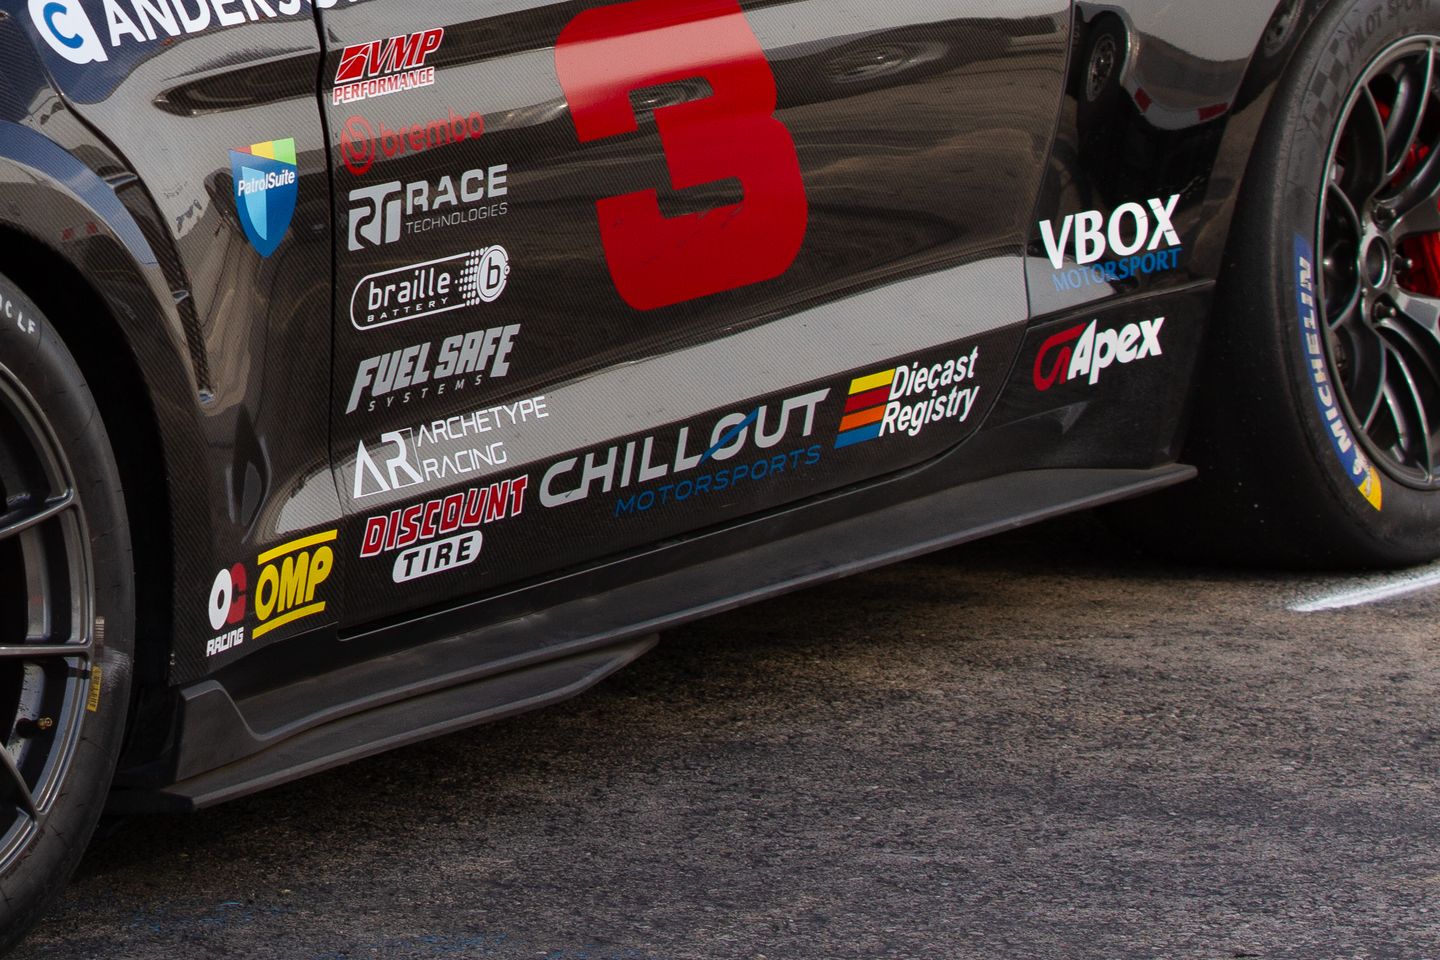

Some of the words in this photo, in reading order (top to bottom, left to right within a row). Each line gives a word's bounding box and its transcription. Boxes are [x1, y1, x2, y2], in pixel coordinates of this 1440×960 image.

[367, 27, 444, 76] VMP
[333, 67, 435, 105] PERFORMANCE
[379, 107, 484, 157] brembo
[238, 170, 295, 196] PatrolSuite
[406, 164, 508, 215] RACE
[406, 202, 508, 234] TECHNOLOGIES
[1039, 194, 1181, 269] VBOX
[368, 267, 450, 310] braille
[1052, 247, 1183, 292] MOTORSPORT
[17, 312, 35, 334] LF
[367, 296, 448, 322] BATTERY
[888, 346, 979, 401] Diecast
[1067, 317, 1165, 385] Apex
[1299, 256, 1352, 454] MICHELIN
[368, 374, 482, 412] SYSTEMS
[879, 386, 979, 439] Registry
[417, 396, 549, 447] ARCHETYPE
[422, 441, 507, 481] RACING
[615, 444, 822, 518] MOTORSPORTS
[359, 474, 528, 558] DISCOUNT
[403, 536, 474, 577] TIRE
[255, 546, 334, 620] OMP
[206, 626, 244, 657] RACING
